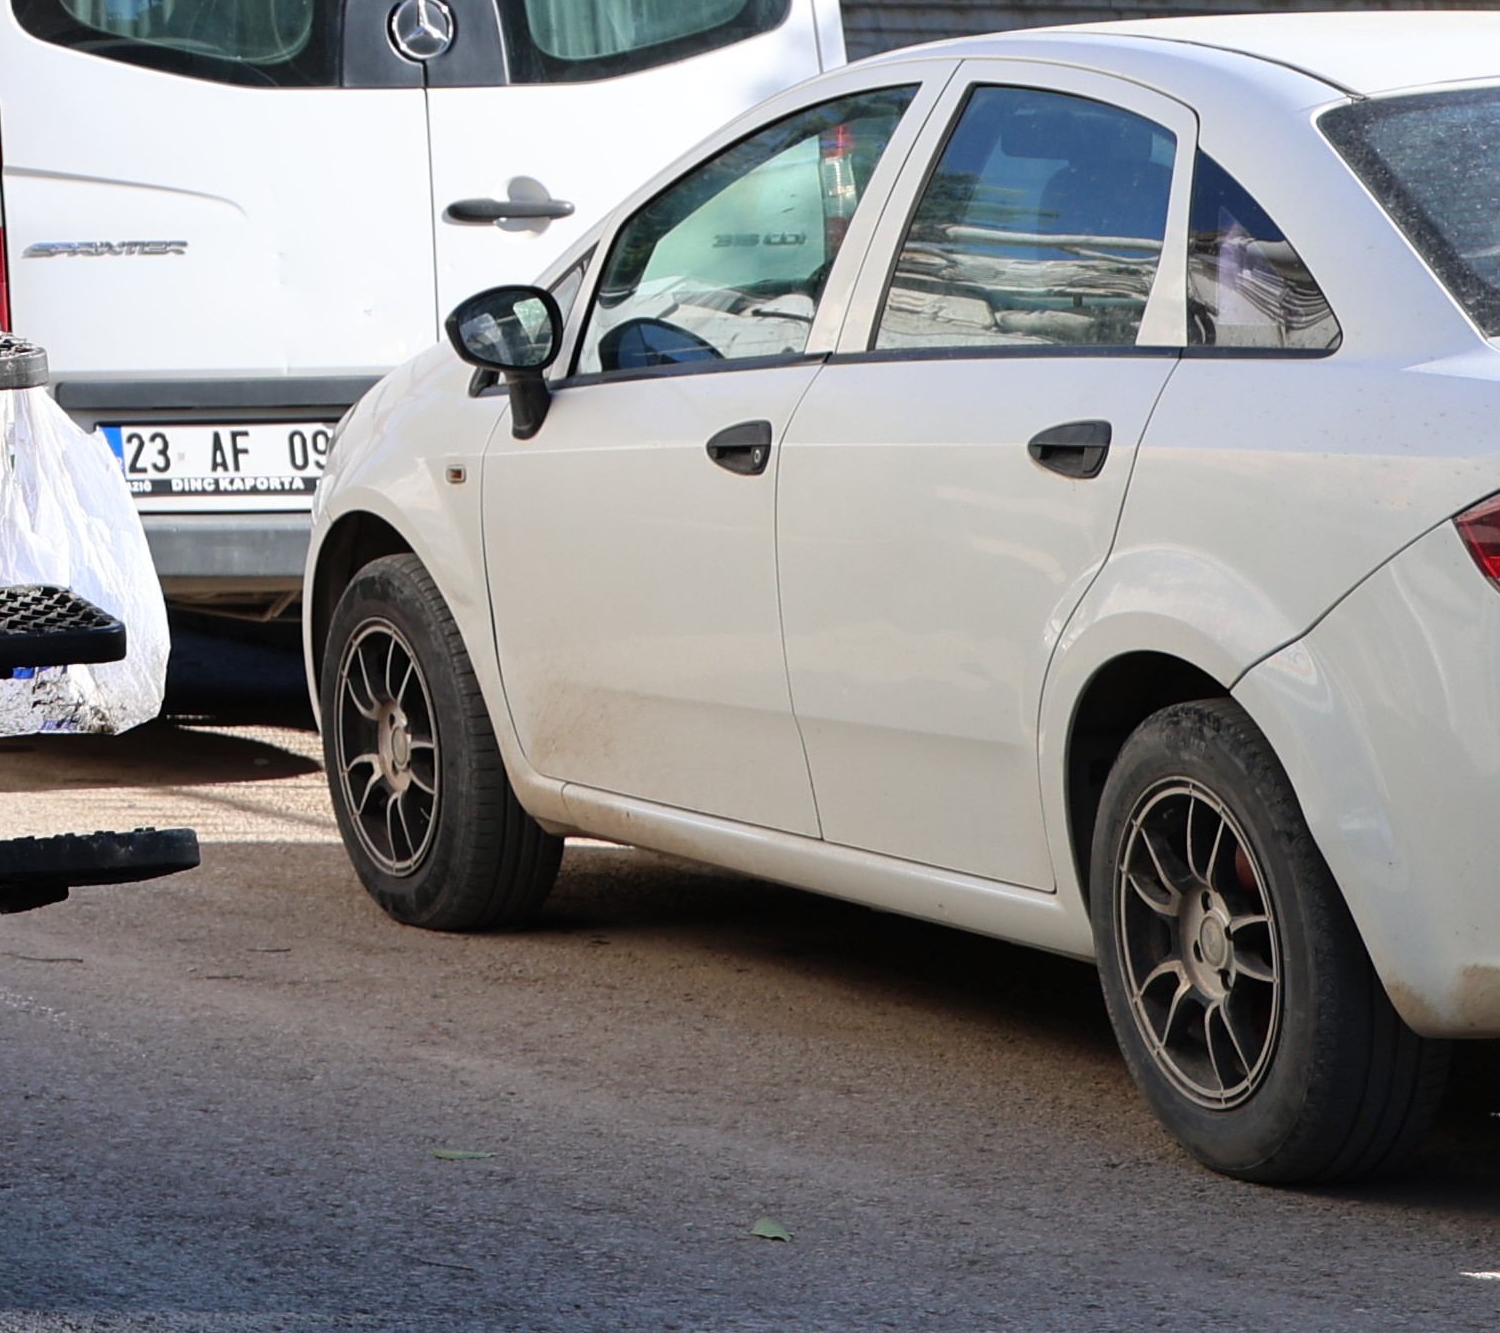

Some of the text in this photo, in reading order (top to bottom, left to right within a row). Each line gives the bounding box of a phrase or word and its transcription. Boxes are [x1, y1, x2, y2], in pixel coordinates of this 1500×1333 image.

[21, 240, 188, 258] SPRINTER
[126, 429, 331, 474] 23 AF 09
[218, 476, 305, 493] KAPORTA
